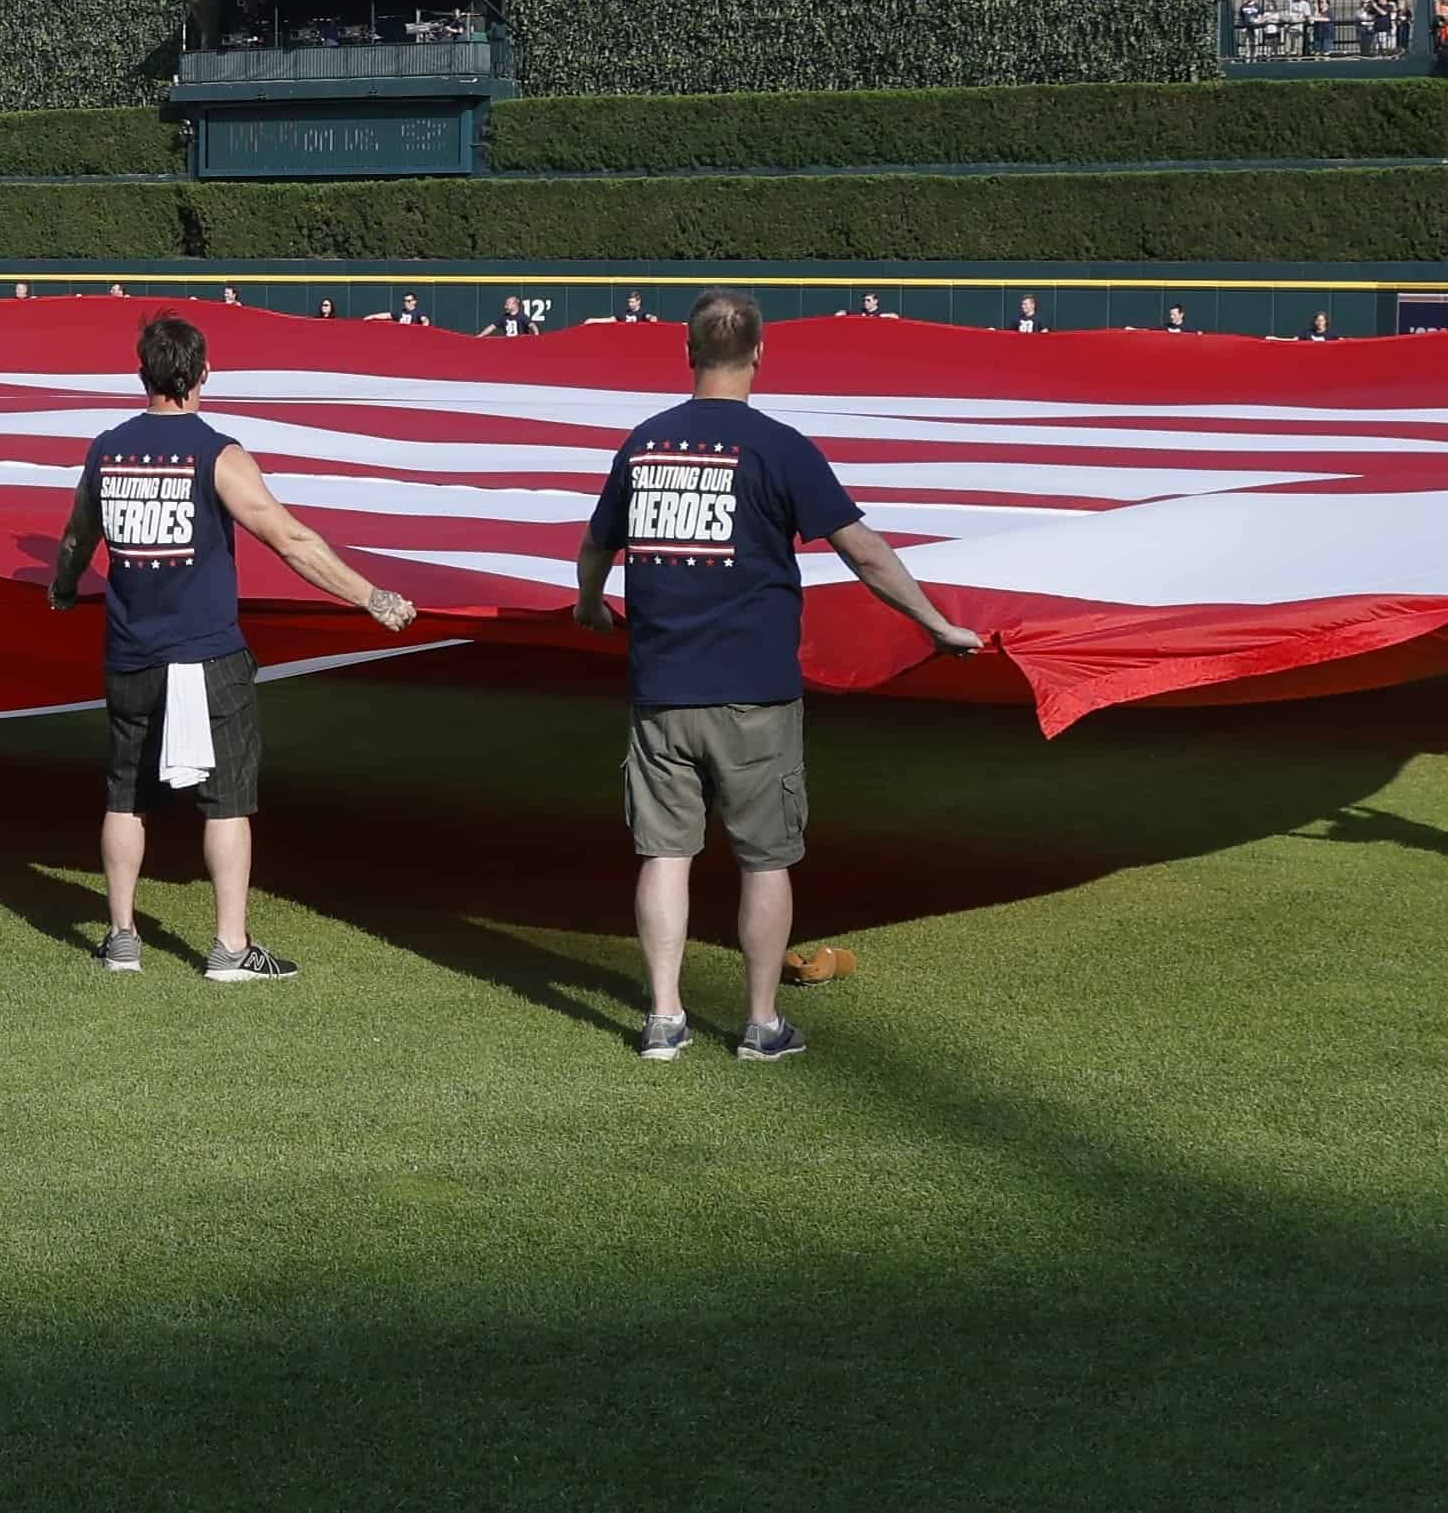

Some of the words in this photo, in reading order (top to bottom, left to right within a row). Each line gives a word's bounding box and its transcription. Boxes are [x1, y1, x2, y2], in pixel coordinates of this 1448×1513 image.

[101, 477, 160, 499] SALUTING
[160, 479, 192, 500] OUR
[631, 465, 699, 491] SALUTING
[699, 468, 734, 492] OUR
[628, 491, 736, 542] HEROES
